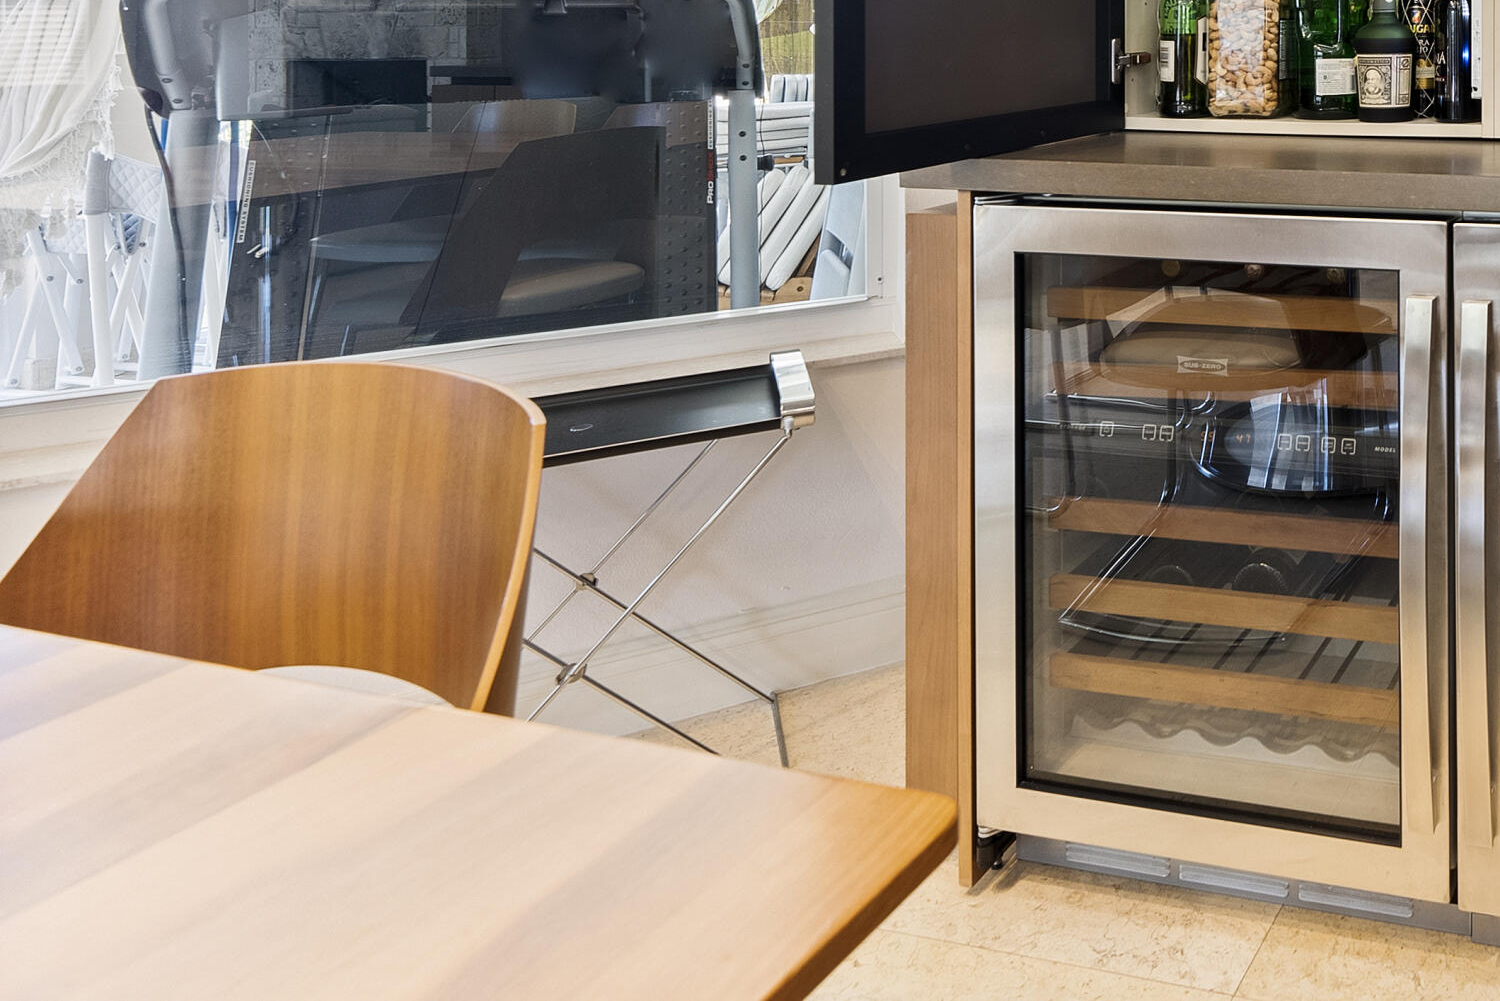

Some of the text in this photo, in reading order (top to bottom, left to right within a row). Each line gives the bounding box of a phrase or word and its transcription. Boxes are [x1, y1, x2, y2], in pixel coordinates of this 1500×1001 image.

[238, 162, 256, 241] CUSHIONING SYSTEM
[1183, 361, 1222, 371] SUB-ZERO
[1374, 446, 1396, 454] MODEL
